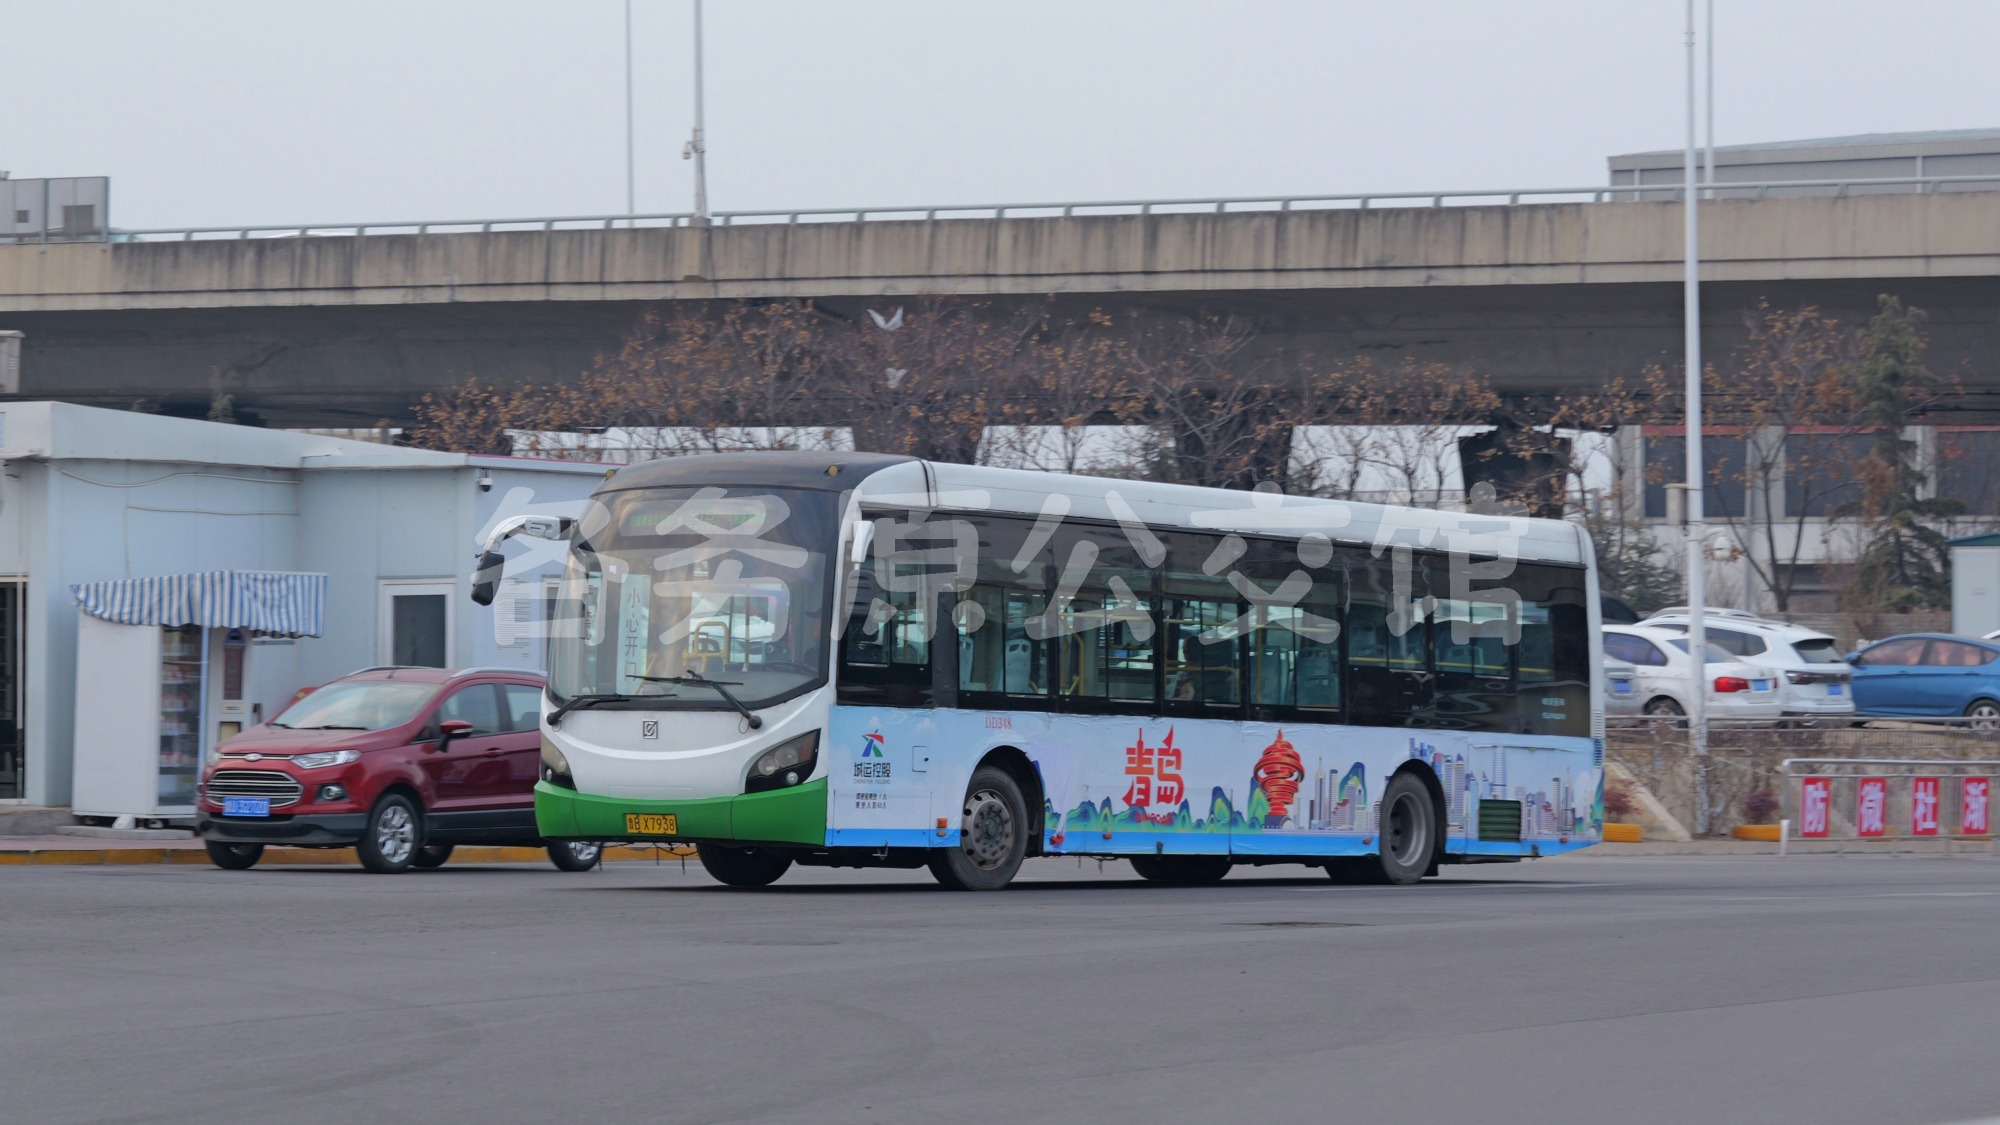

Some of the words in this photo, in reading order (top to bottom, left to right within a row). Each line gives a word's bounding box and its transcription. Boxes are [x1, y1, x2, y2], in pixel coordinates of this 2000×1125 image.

[624, 587, 641, 681] 小心开门
[853, 762, 891, 778] 城运控股
